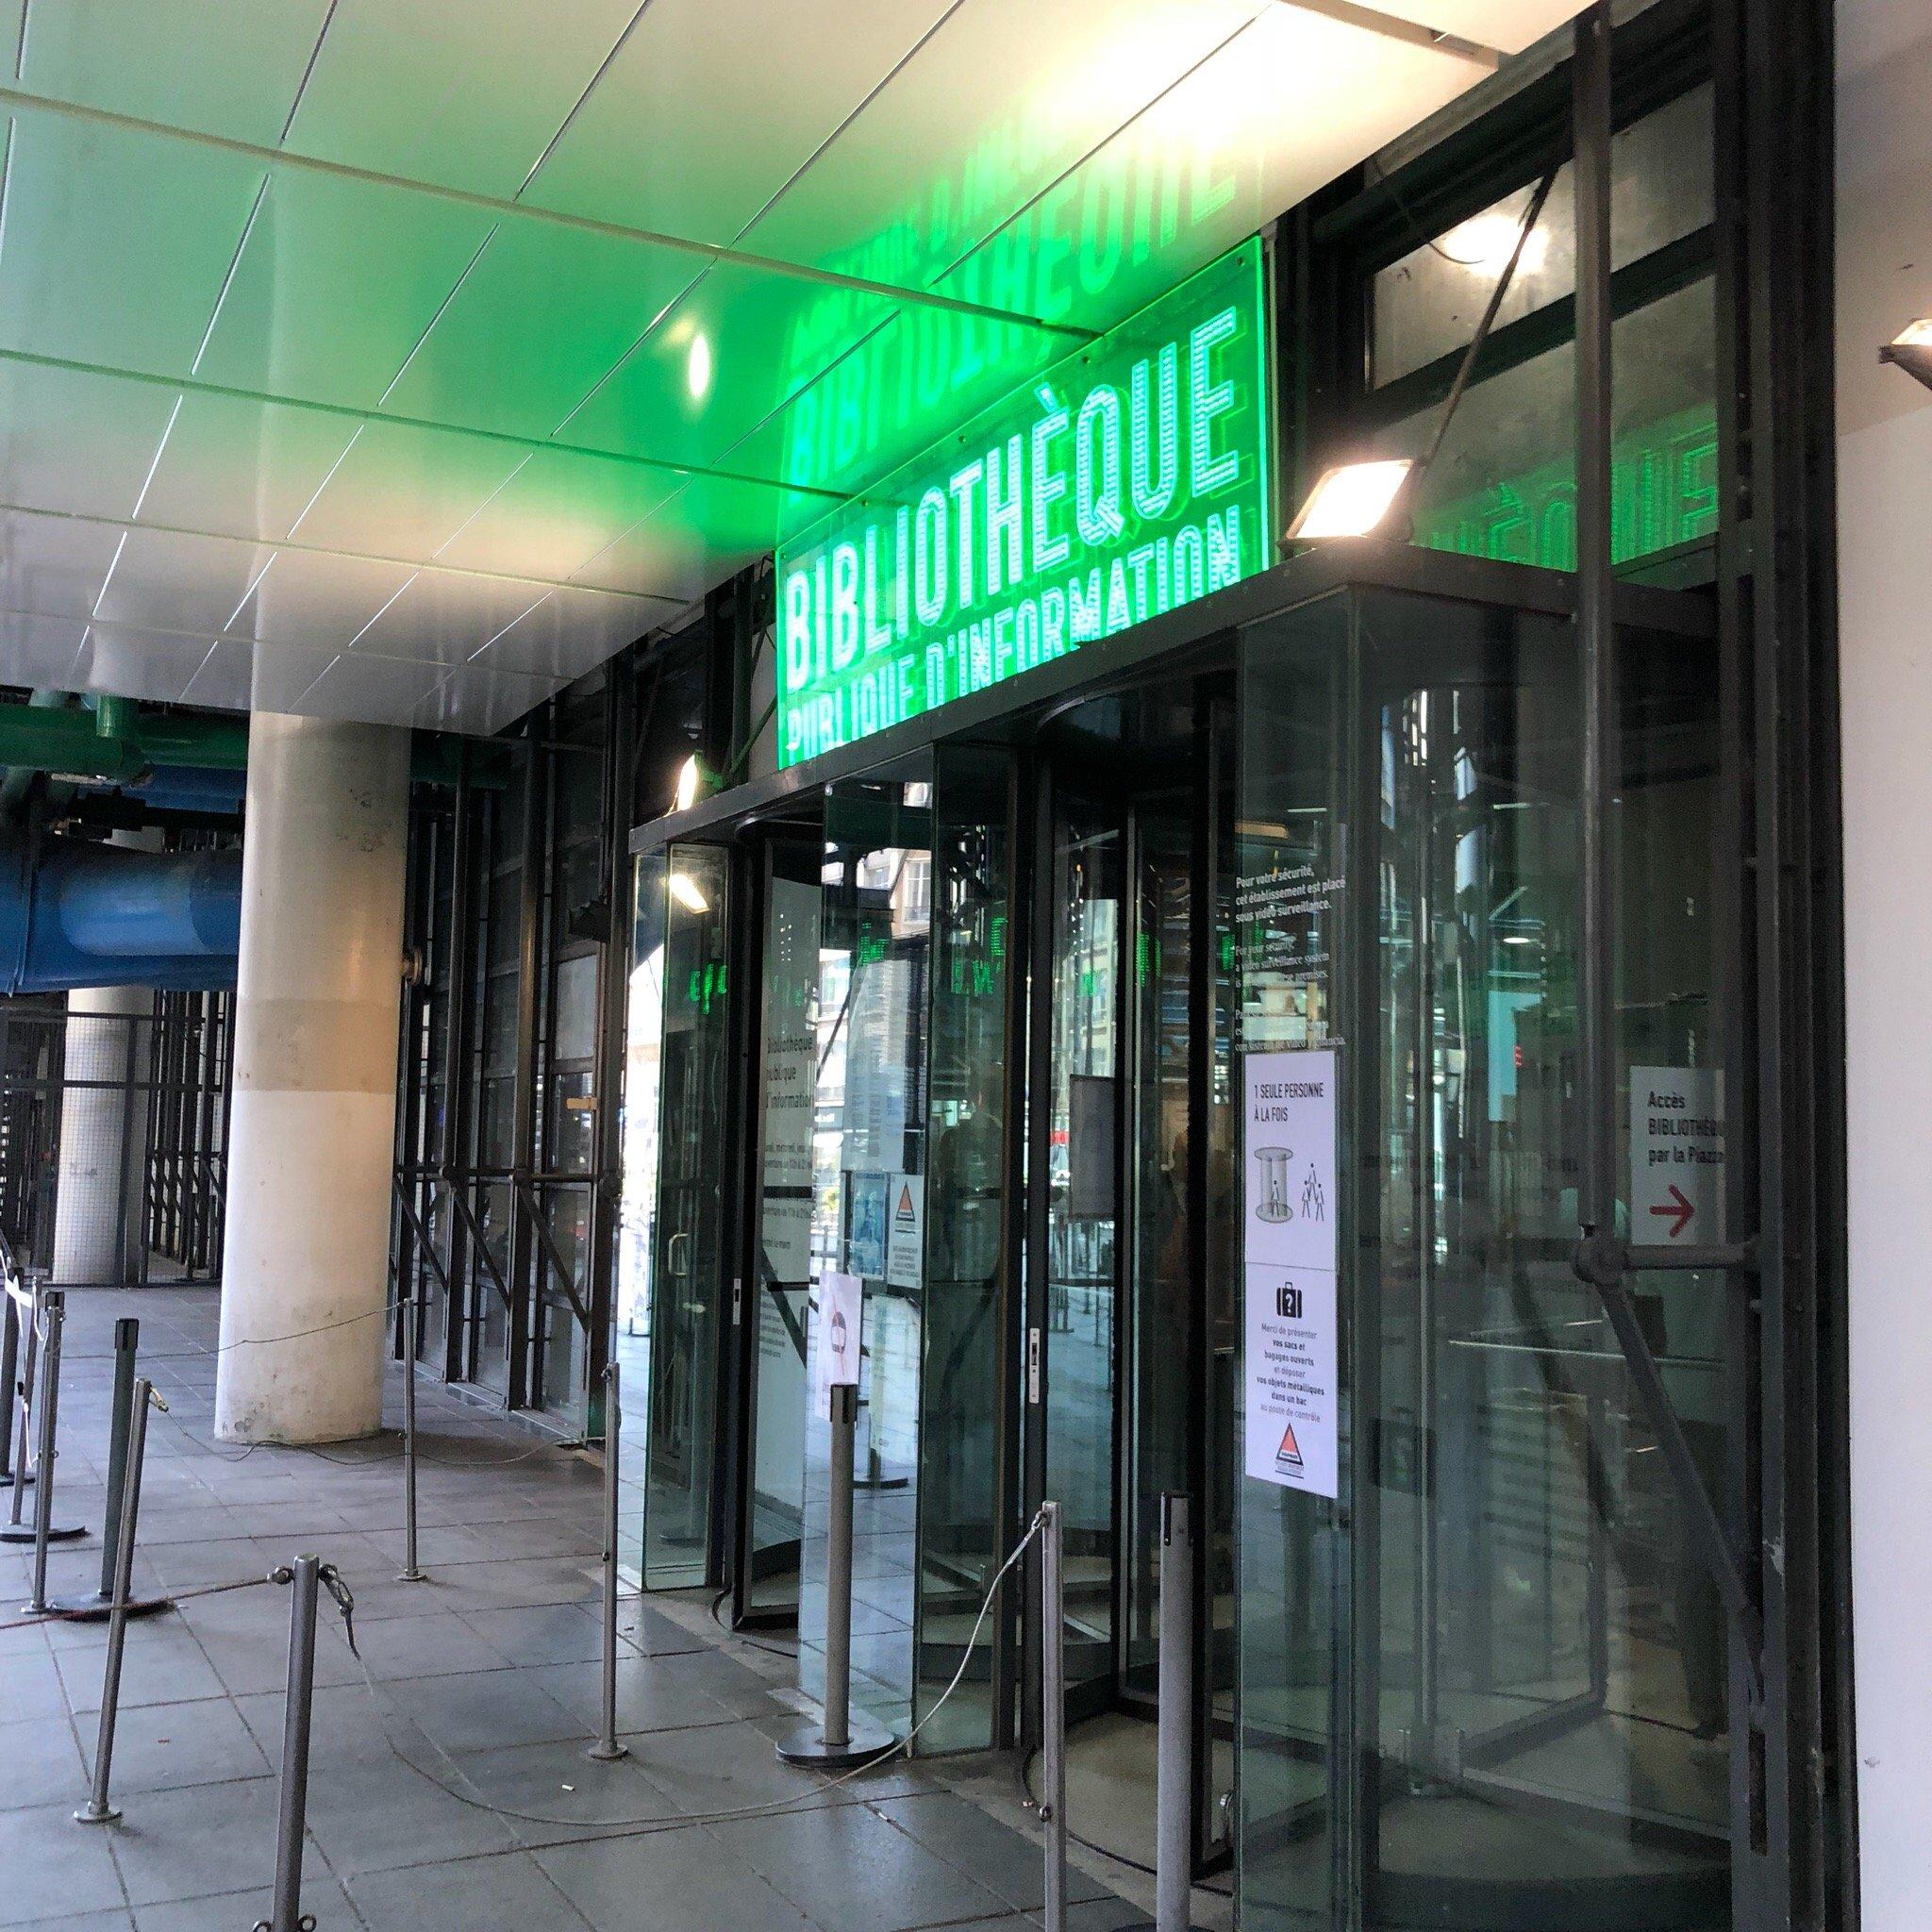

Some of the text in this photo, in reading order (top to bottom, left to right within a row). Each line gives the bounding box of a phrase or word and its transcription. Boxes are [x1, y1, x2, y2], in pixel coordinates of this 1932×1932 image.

[785, 305, 1240, 691] BIBLIOTHÈQUE
[924, 504, 1241, 711] D'INFORMATION
[1236, 863, 1315, 889] Pour votre sécurité,
[1236, 874, 1346, 906] cet établissement est placé
[1236, 912, 1254, 923] sous
[1255, 1082, 1324, 1099] 1 SEULE PERSONNE
[1647, 1091, 1686, 1109] Accès
[1254, 1105, 1289, 1122] À LA FOIS
[1648, 1147, 1669, 1167] par
[1673, 1145, 1686, 1164] la
[1261, 1324, 1277, 1334] Merci
[1278, 1326, 1286, 1335] de
[1284, 1341, 1297, 1350] sacs
[1264, 1350, 1314, 1367] bagages ouverts
[1257, 1375, 1267, 1384] vos
[1267, 1377, 1286, 1389] objets
[1271, 1391, 1307, 1406] dans un bac
[1286, 1407, 1293, 1416] de
